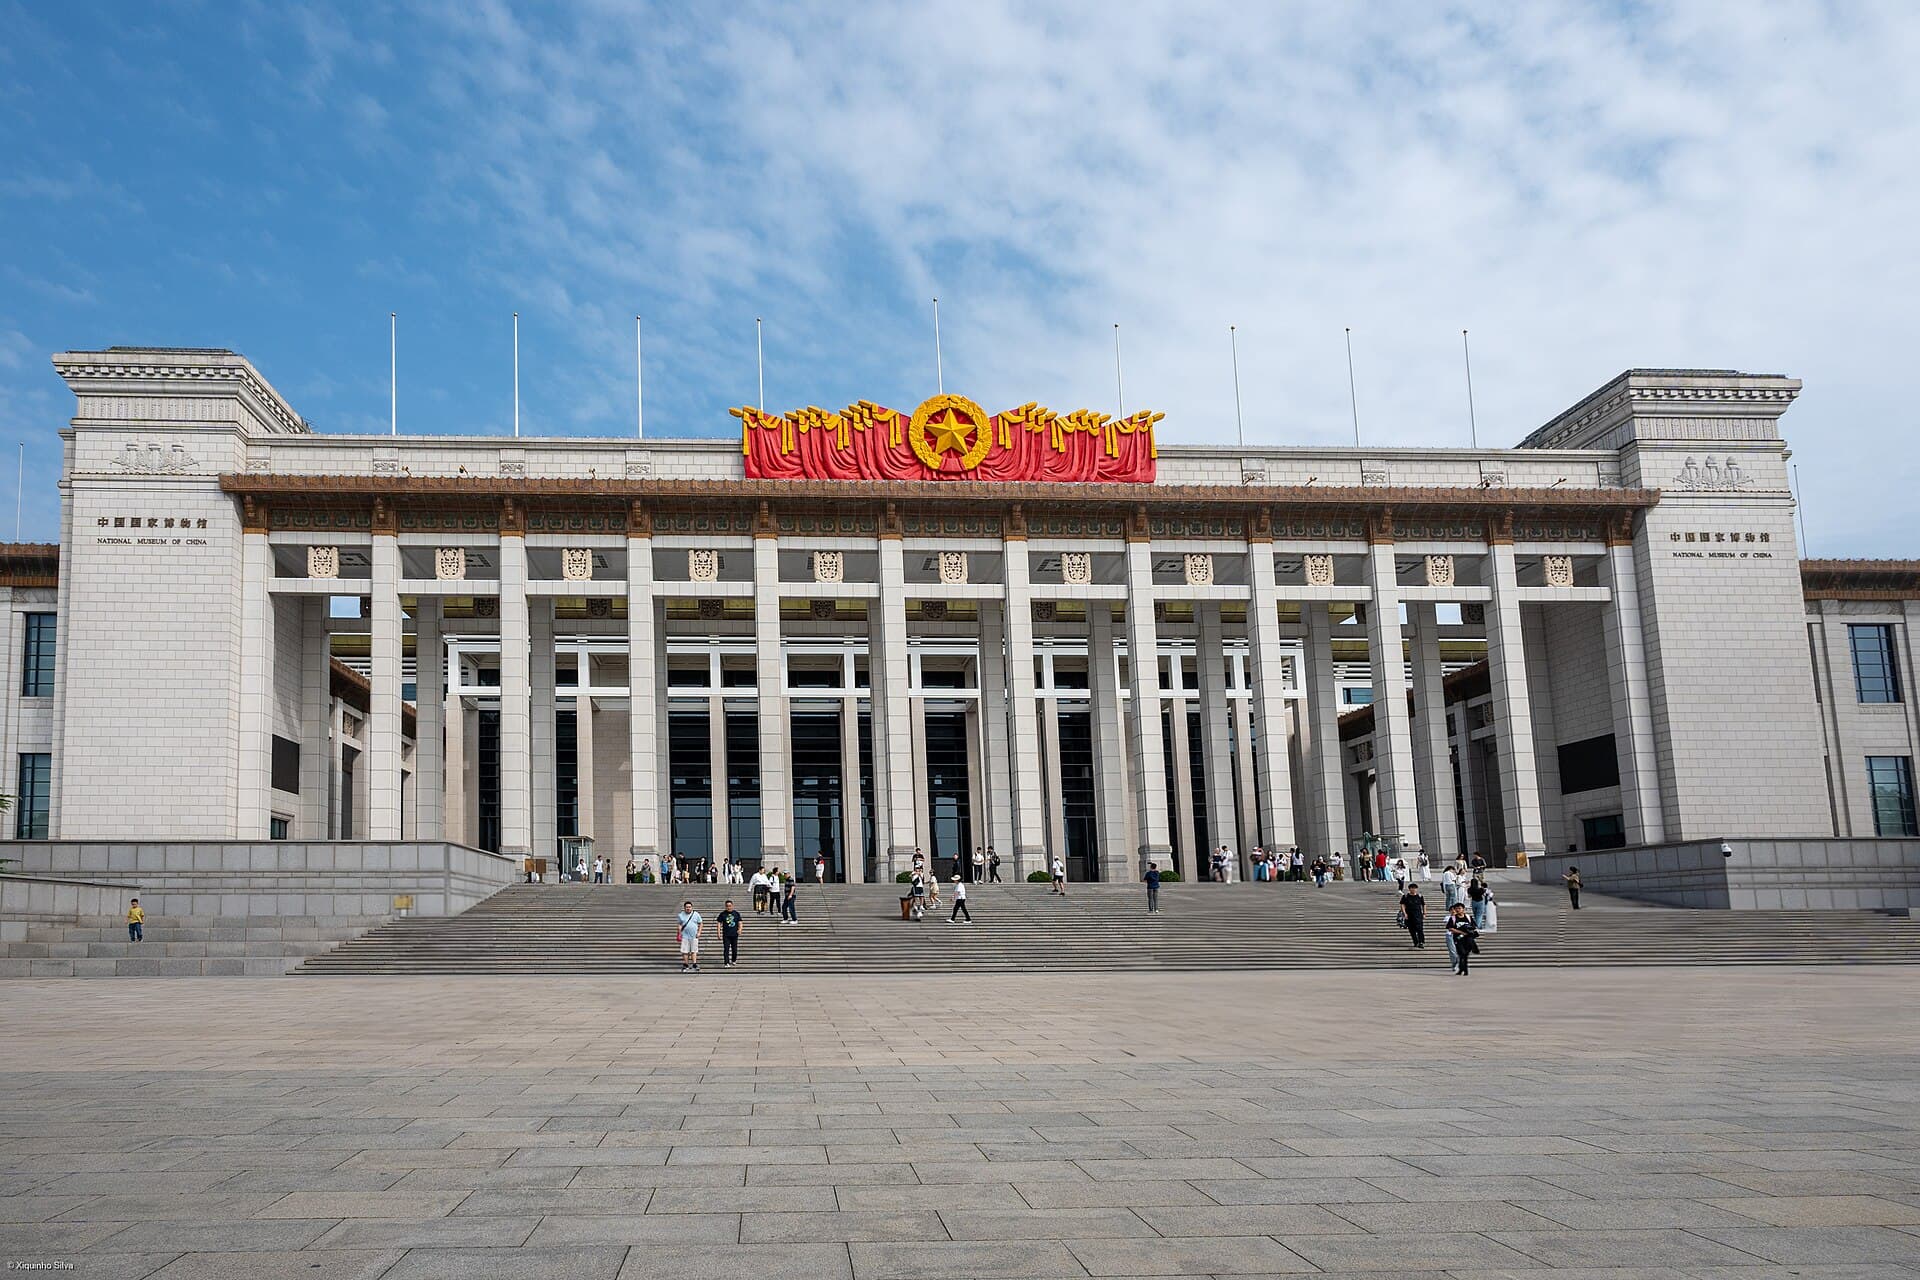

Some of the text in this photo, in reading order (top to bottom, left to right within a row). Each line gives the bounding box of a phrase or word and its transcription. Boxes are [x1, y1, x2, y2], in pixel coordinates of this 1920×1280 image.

[97, 517, 207, 528] 中国国家博物馆
[1670, 532, 1770, 543] 中国国家博物馆
